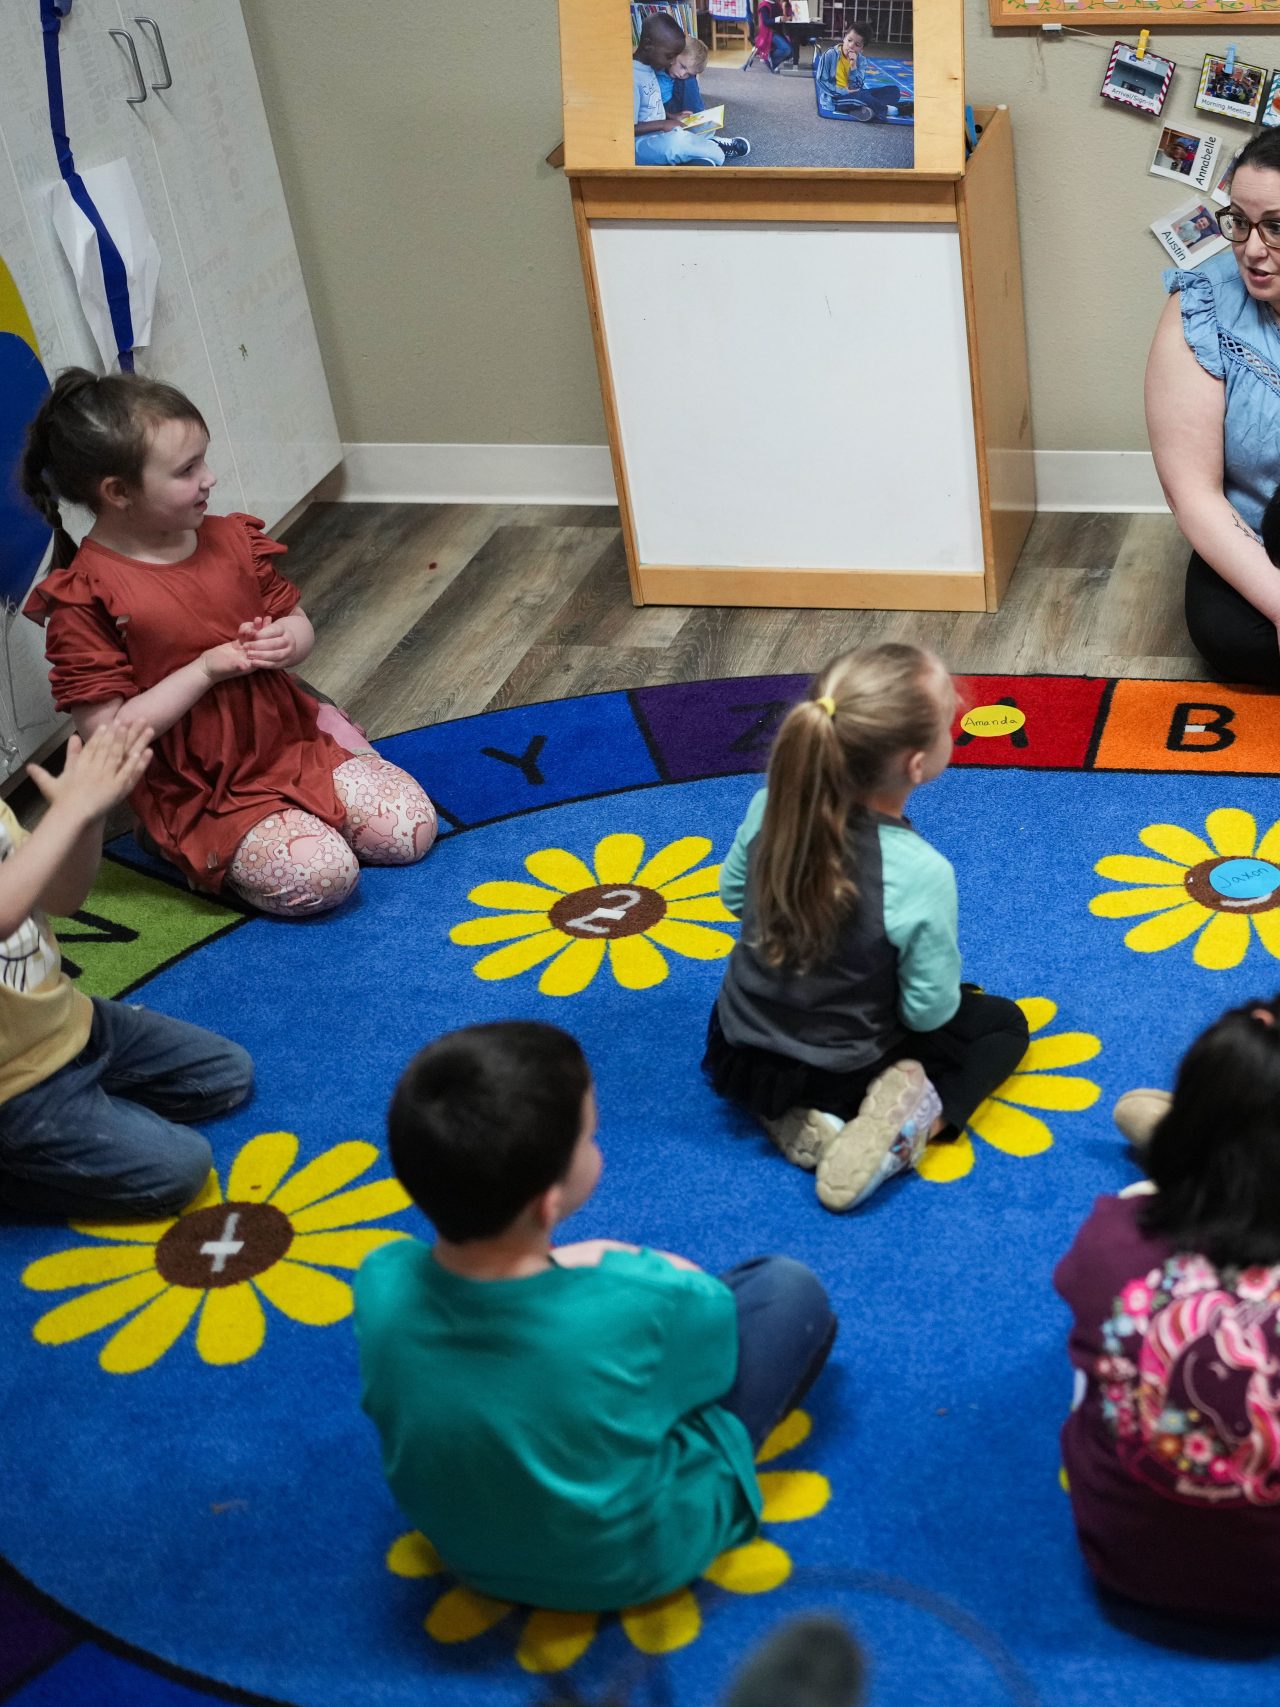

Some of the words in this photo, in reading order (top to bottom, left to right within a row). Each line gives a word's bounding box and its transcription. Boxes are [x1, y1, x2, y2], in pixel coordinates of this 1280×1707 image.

[1201, 99, 1226, 111] Morning
[1227, 105, 1252, 117] Meeting
[1195, 136, 1217, 186] Annabelle
[1161, 230, 1187, 262] Austin
[964, 715, 1018, 727] Amanda
[1165, 702, 1238, 753] B
[480, 734, 548, 786] Y
[1220, 867, 1269, 889] Jaxon
[565, 889, 641, 934] 2
